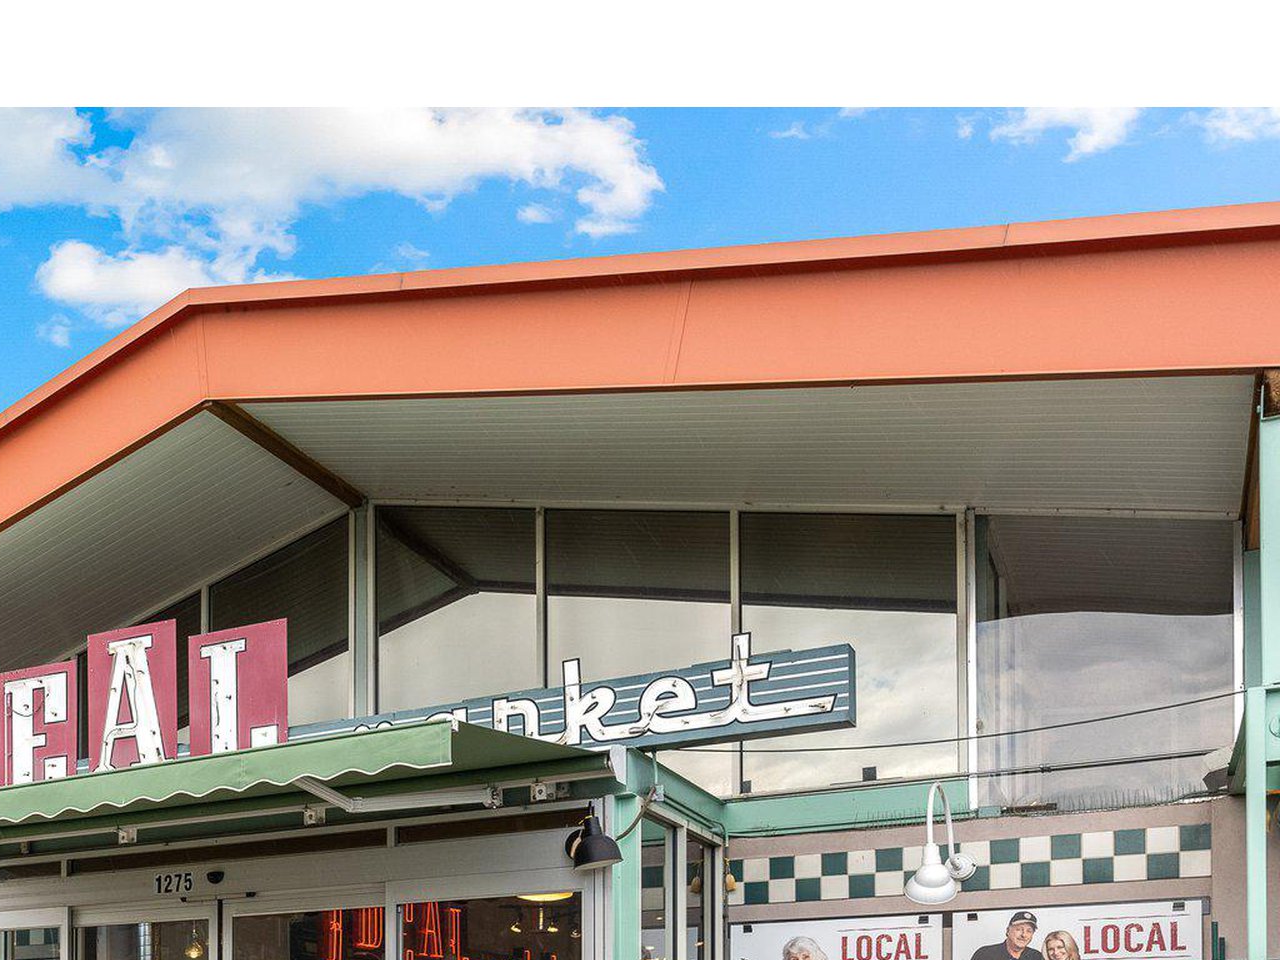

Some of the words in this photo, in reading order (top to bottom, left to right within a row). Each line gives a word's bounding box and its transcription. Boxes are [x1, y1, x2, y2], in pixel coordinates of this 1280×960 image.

[352, 632, 838, 746] rket
[155, 872, 193, 894] 1275
[1083, 921, 1187, 955] LOCAL
